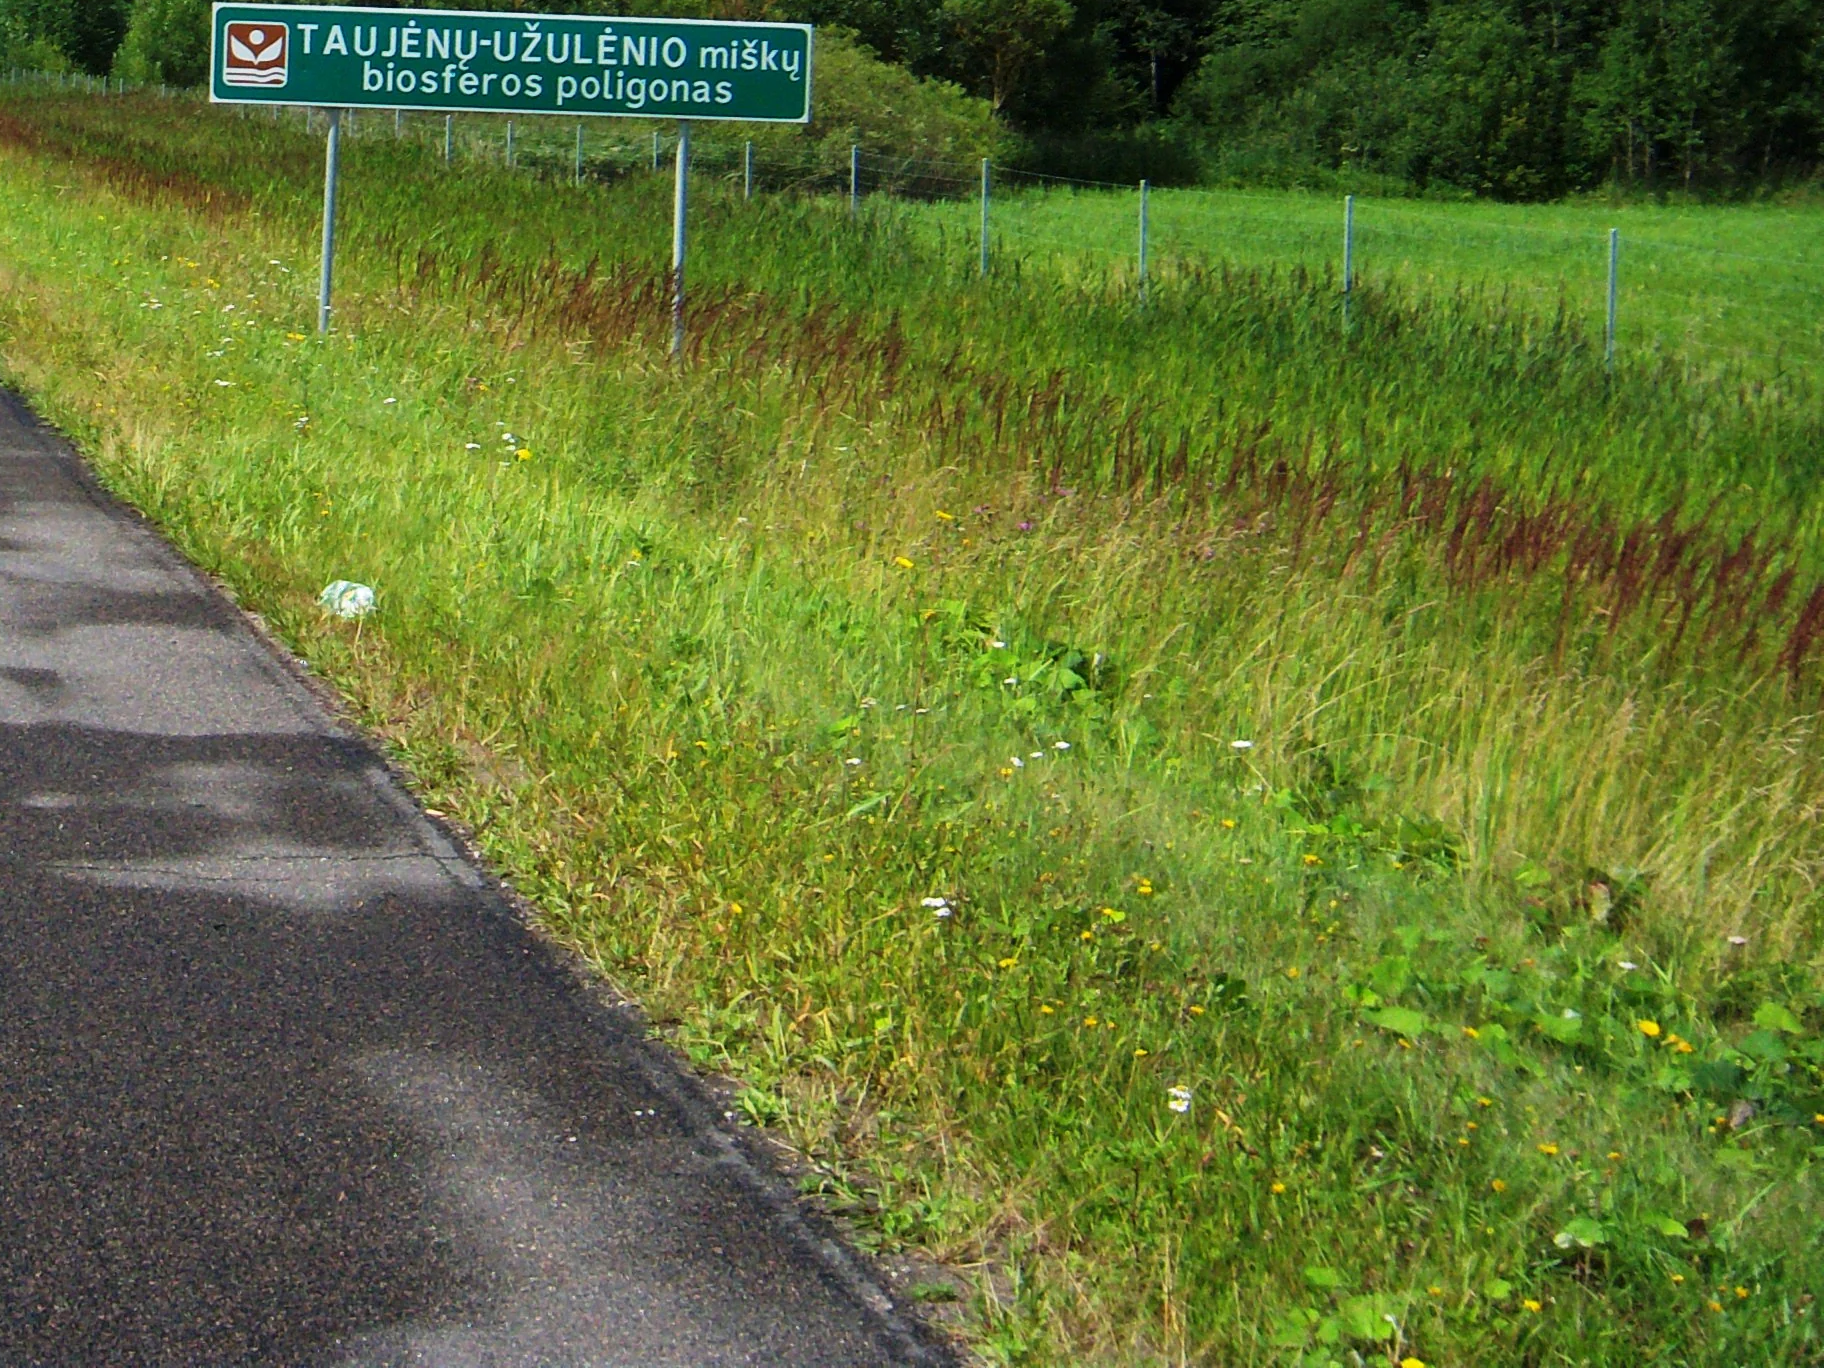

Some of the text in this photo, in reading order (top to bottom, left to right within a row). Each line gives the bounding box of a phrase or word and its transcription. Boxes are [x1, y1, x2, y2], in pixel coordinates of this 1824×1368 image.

[297, 19, 801, 82] TAUJĖNŲ-UŽULĖNIO miškų
[363, 61, 733, 109] biosferos poligonas
